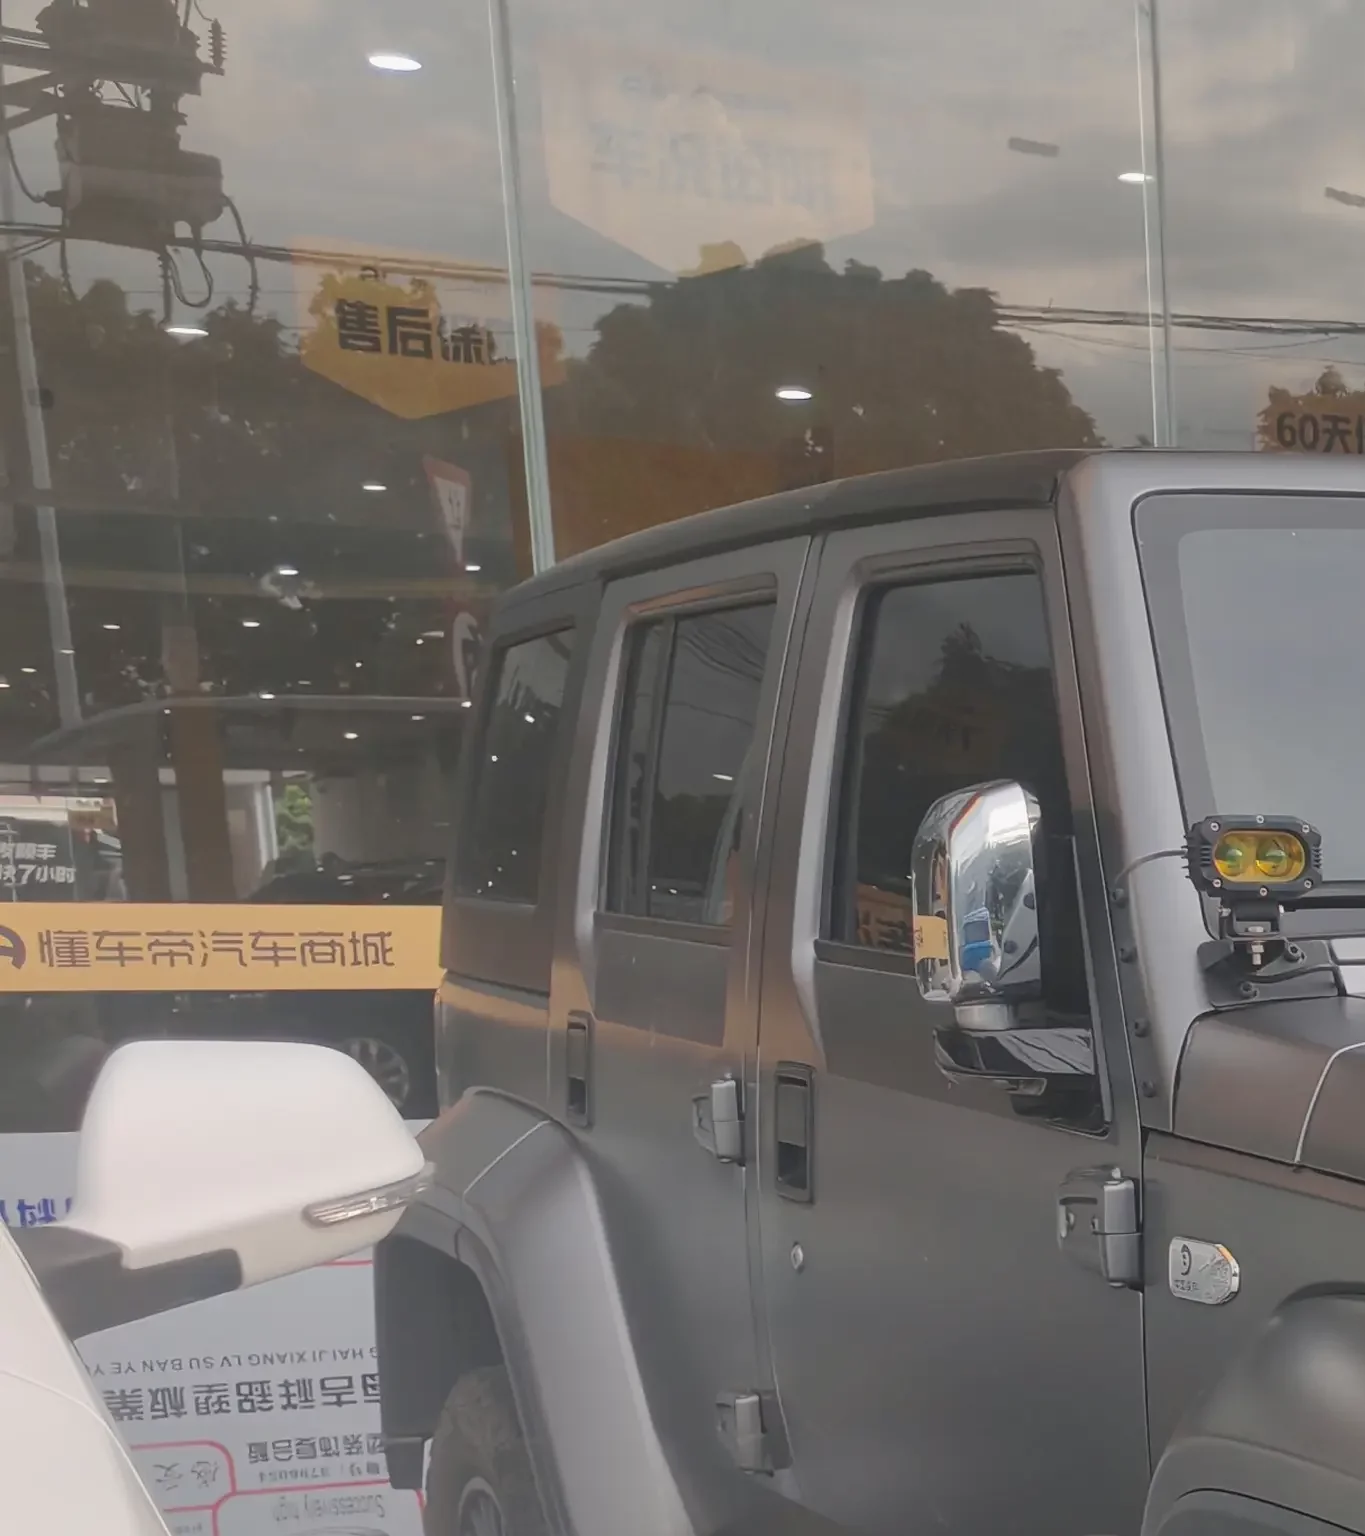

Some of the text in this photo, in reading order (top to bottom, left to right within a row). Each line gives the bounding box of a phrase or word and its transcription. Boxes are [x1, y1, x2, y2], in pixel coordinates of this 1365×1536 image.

[37, 929, 396, 969] 懂车帝汽车商城
[247, 1351, 307, 1366] XIANG
[332, 1347, 364, 1362] HAI
[141, 1358, 184, 1373] BAN
[189, 1356, 215, 1370] SU
